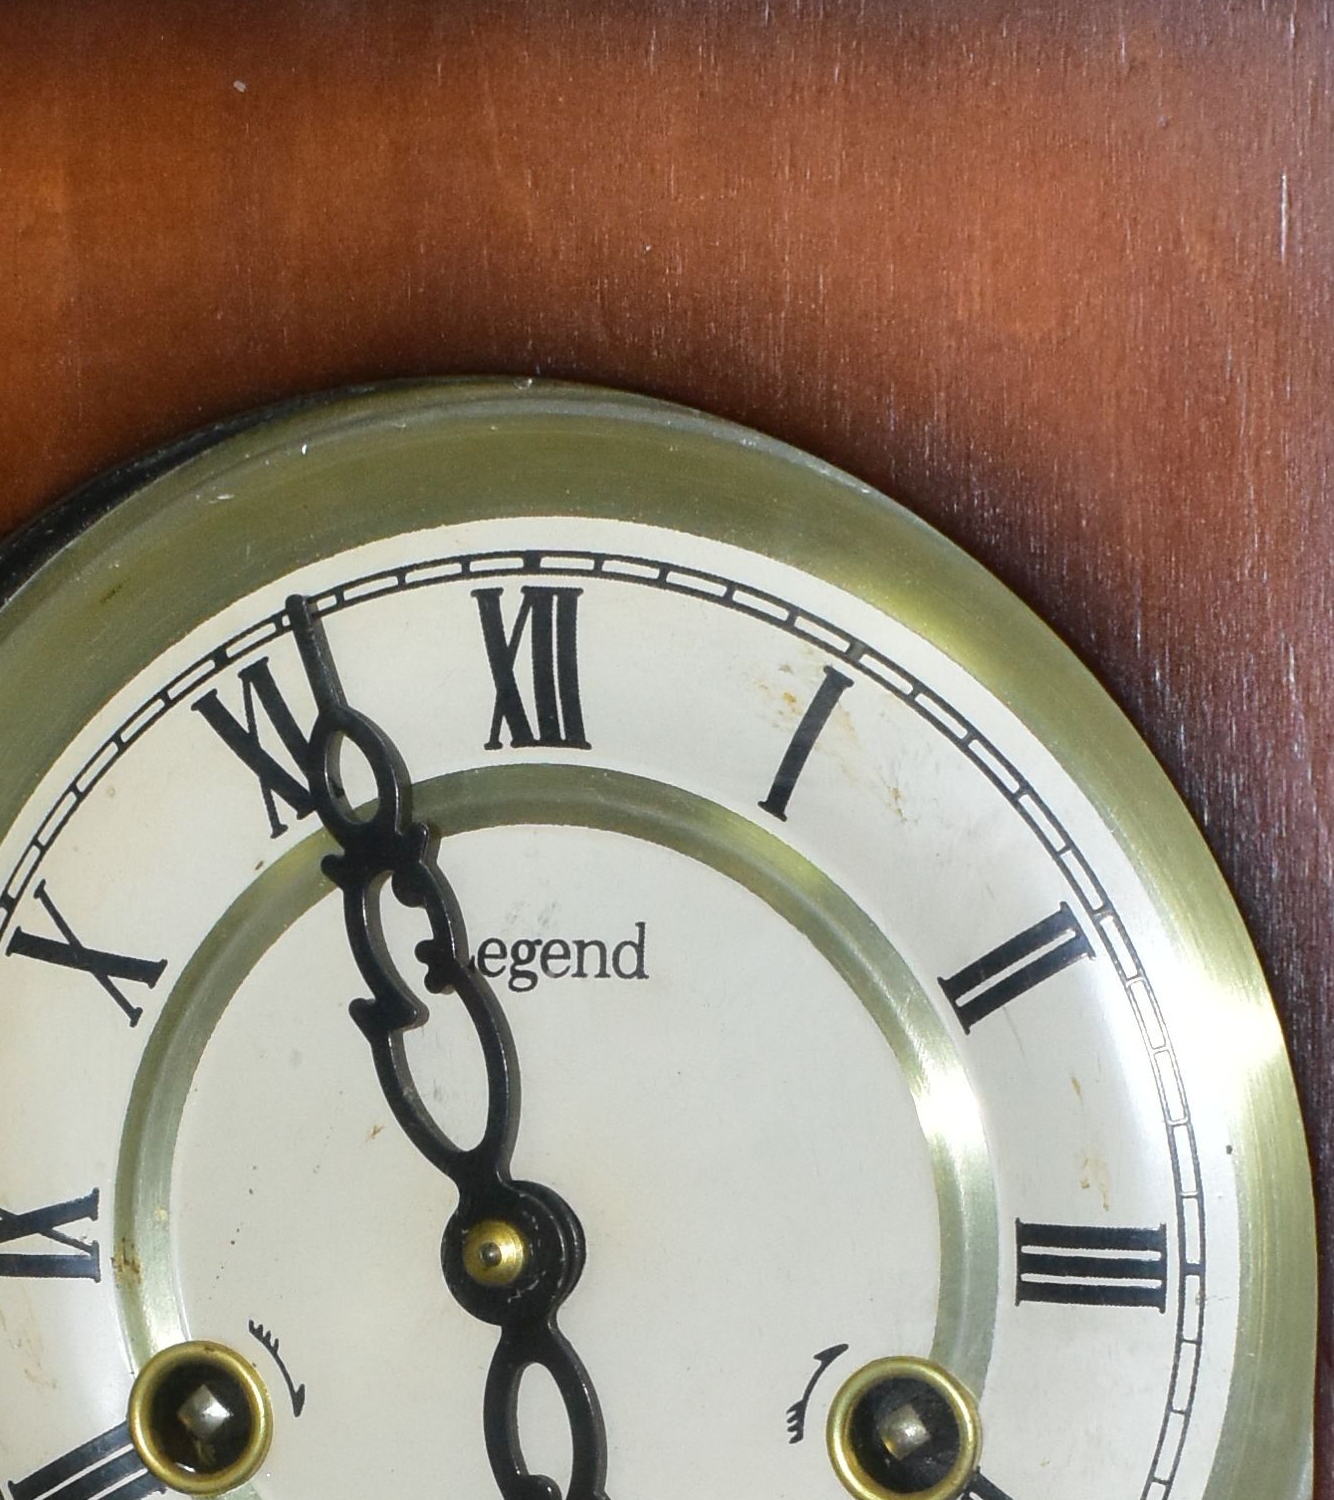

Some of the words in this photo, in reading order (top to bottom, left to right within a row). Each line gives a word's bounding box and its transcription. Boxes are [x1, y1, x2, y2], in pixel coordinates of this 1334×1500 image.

[470, 586, 593, 750] XII
[758, 665, 855, 822] I
[5, 879, 168, 1028] X
[468, 922, 649, 992] egend
[937, 901, 1096, 1035] II
[1014, 1217, 1168, 1315] III
